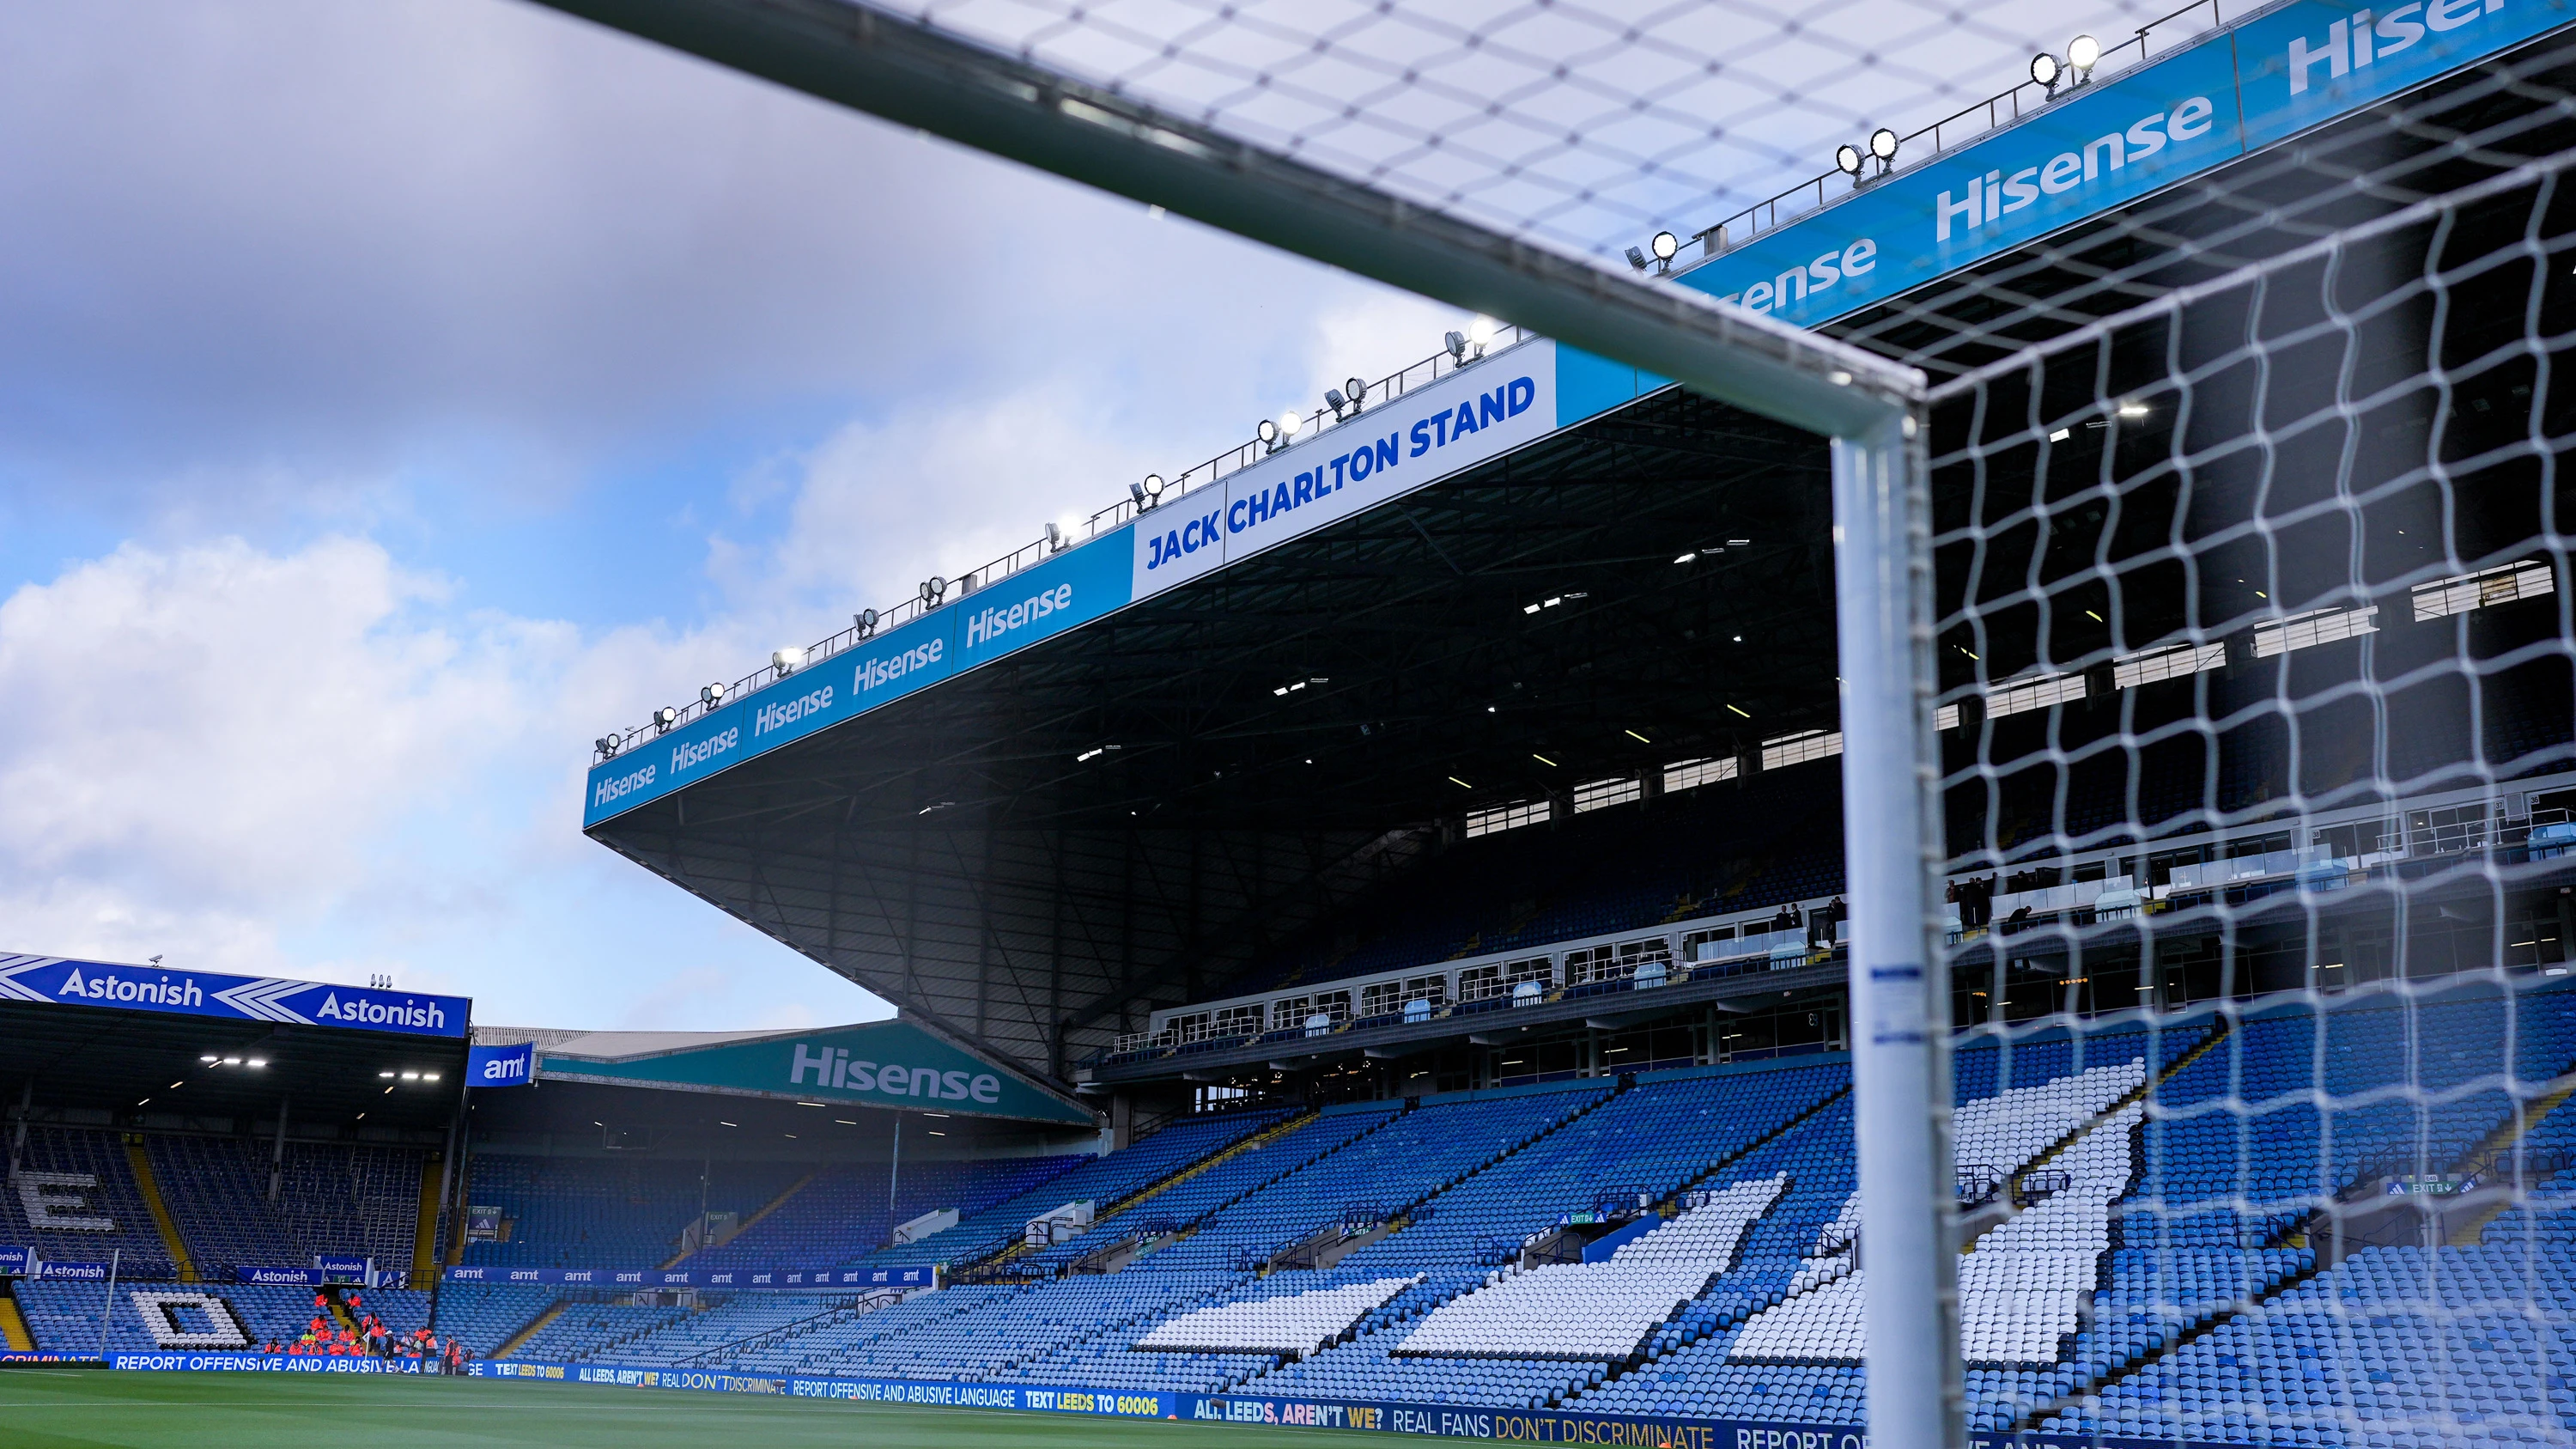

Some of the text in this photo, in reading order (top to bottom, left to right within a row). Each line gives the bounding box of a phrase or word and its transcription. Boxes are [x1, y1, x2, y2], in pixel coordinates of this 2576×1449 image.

[2288, 0, 2505, 96] Hise
[1935, 96, 2213, 242] Hisense
[1147, 376, 1535, 570] JACK CHARLTON STAND
[966, 583, 1072, 648] Hisense
[853, 638, 944, 696] Hisense
[755, 685, 834, 737] Hisense
[670, 727, 738, 775] Hisense
[594, 764, 656, 807] Hisense
[58, 967, 203, 1007] Astonish
[316, 991, 445, 1029] Astonish
[484, 1053, 526, 1079] amt
[789, 1043, 1000, 1104] Hisense
[2412, 1184, 2435, 1193] EXIT
[1571, 1215, 1584, 1223] EXIT
[1142, 1245, 1153, 1254] EXIT
[43, 1263, 105, 1279] Astonish
[325, 1262, 362, 1271] Astonish
[454, 1268, 483, 1279] amt
[252, 1269, 307, 1284] Astonish
[510, 1269, 539, 1281] amt
[564, 1271, 592, 1282] amt
[617, 1271, 641, 1282] amt
[665, 1271, 689, 1283] amt
[711, 1272, 732, 1283] amt
[752, 1272, 772, 1283] amt
[787, 1272, 802, 1283] amt
[815, 1271, 829, 1282] amt
[843, 1271, 858, 1282] amt
[872, 1270, 888, 1282] amt
[903, 1269, 920, 1282] amt
[116, 1355, 186, 1370] REPORT
[190, 1356, 283, 1372] OFFENSIVE
[286, 1358, 322, 1372] AND
[495, 1363, 564, 1379] TEXT LEEDS TO 60006
[579, 1367, 659, 1386] ALL LEEDS, AREN'T WE?
[662, 1373, 680, 1388] REAL
[682, 1373, 730, 1391] DON'T
[793, 1379, 1016, 1408] REPORT OFFENSIVE AND ABUSIVE LANGUAGE
[1025, 1391, 1158, 1416] TEXT LEEDS TO 60006
[1225, 1401, 1279, 1426] LEEDS,
[1282, 1403, 1343, 1427] AREN'T
[1347, 1407, 1383, 1430] WE?
[1393, 1409, 1714, 1449] REAL FANS DON'T DISCRIMINATE
